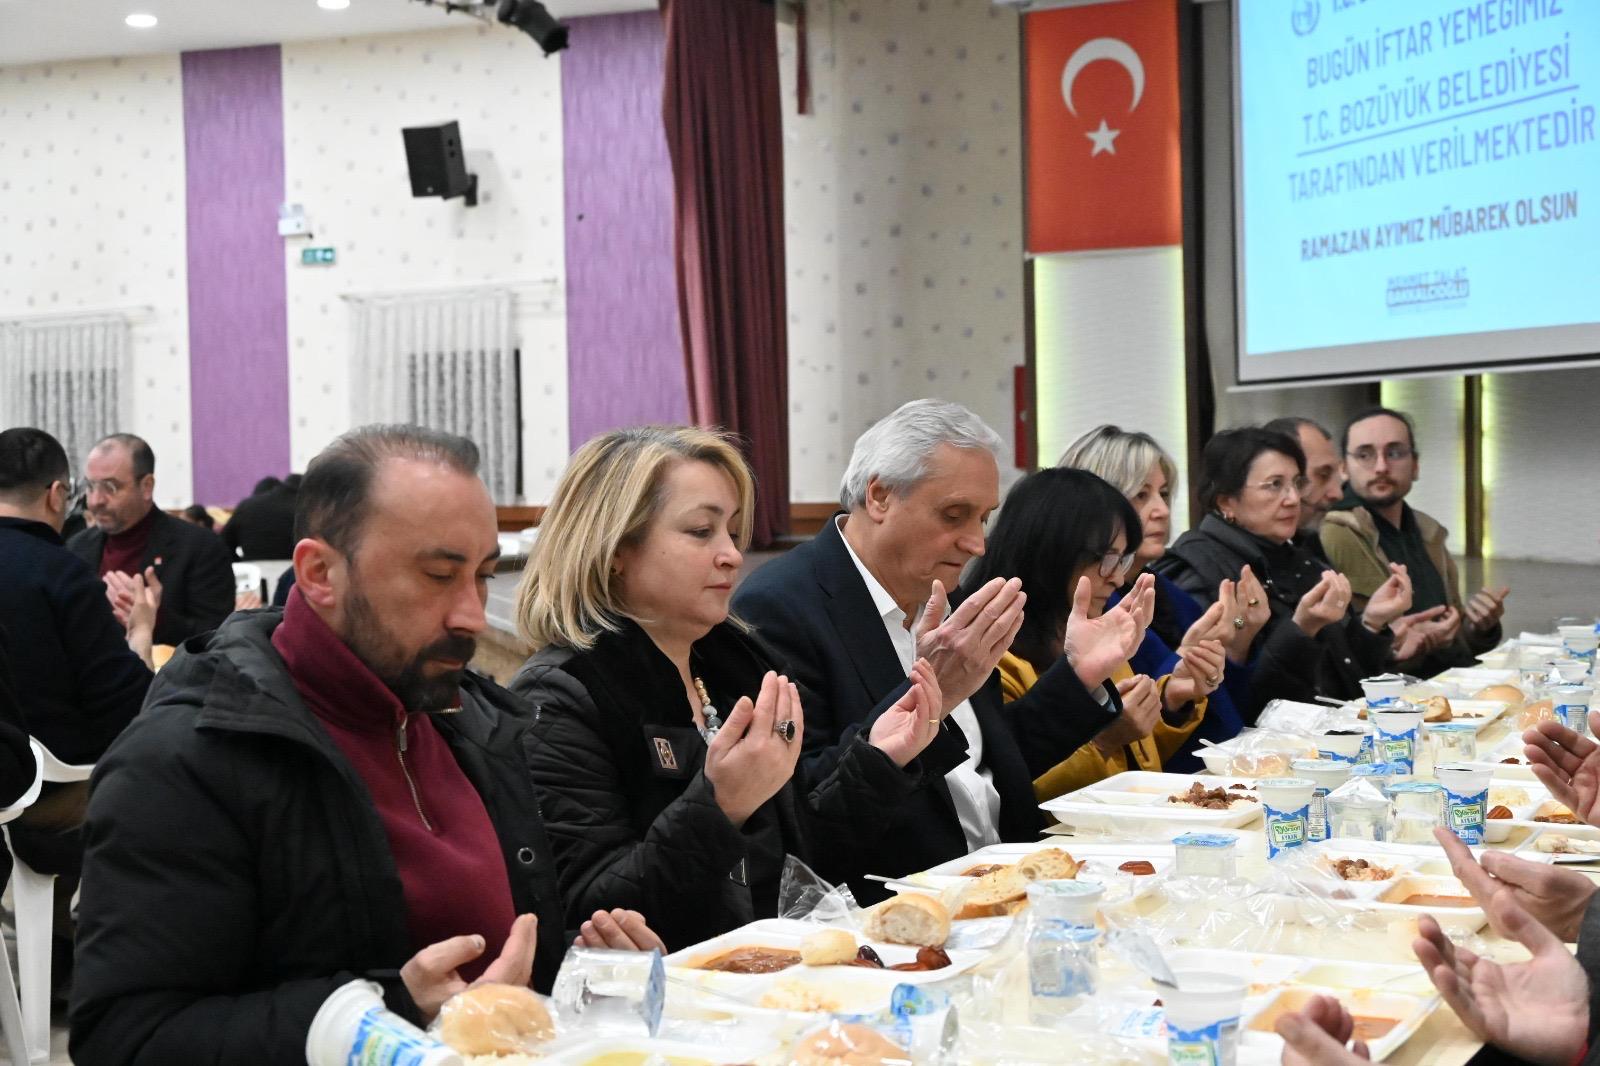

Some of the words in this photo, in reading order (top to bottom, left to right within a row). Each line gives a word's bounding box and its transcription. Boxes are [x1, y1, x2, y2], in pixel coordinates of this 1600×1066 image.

[1303, 110, 1334, 145] T.C.
[1340, 76, 1432, 136] BOZÜYÜK
[1438, 31, 1570, 111] BELEDİYESİ
[1307, 36, 1370, 89] BUGÜN
[1376, 20, 1433, 68] İFTAR
[1289, 148, 1406, 203] TARAFINDAN
[1412, 97, 1596, 178] VERİLMEKTEDİR
[1301, 228, 1370, 262] RAMAZAN
[1375, 218, 1425, 249] AYIMIZ
[1430, 205, 1511, 241] MÜBAREK
[1515, 190, 1578, 227] OLSUN
